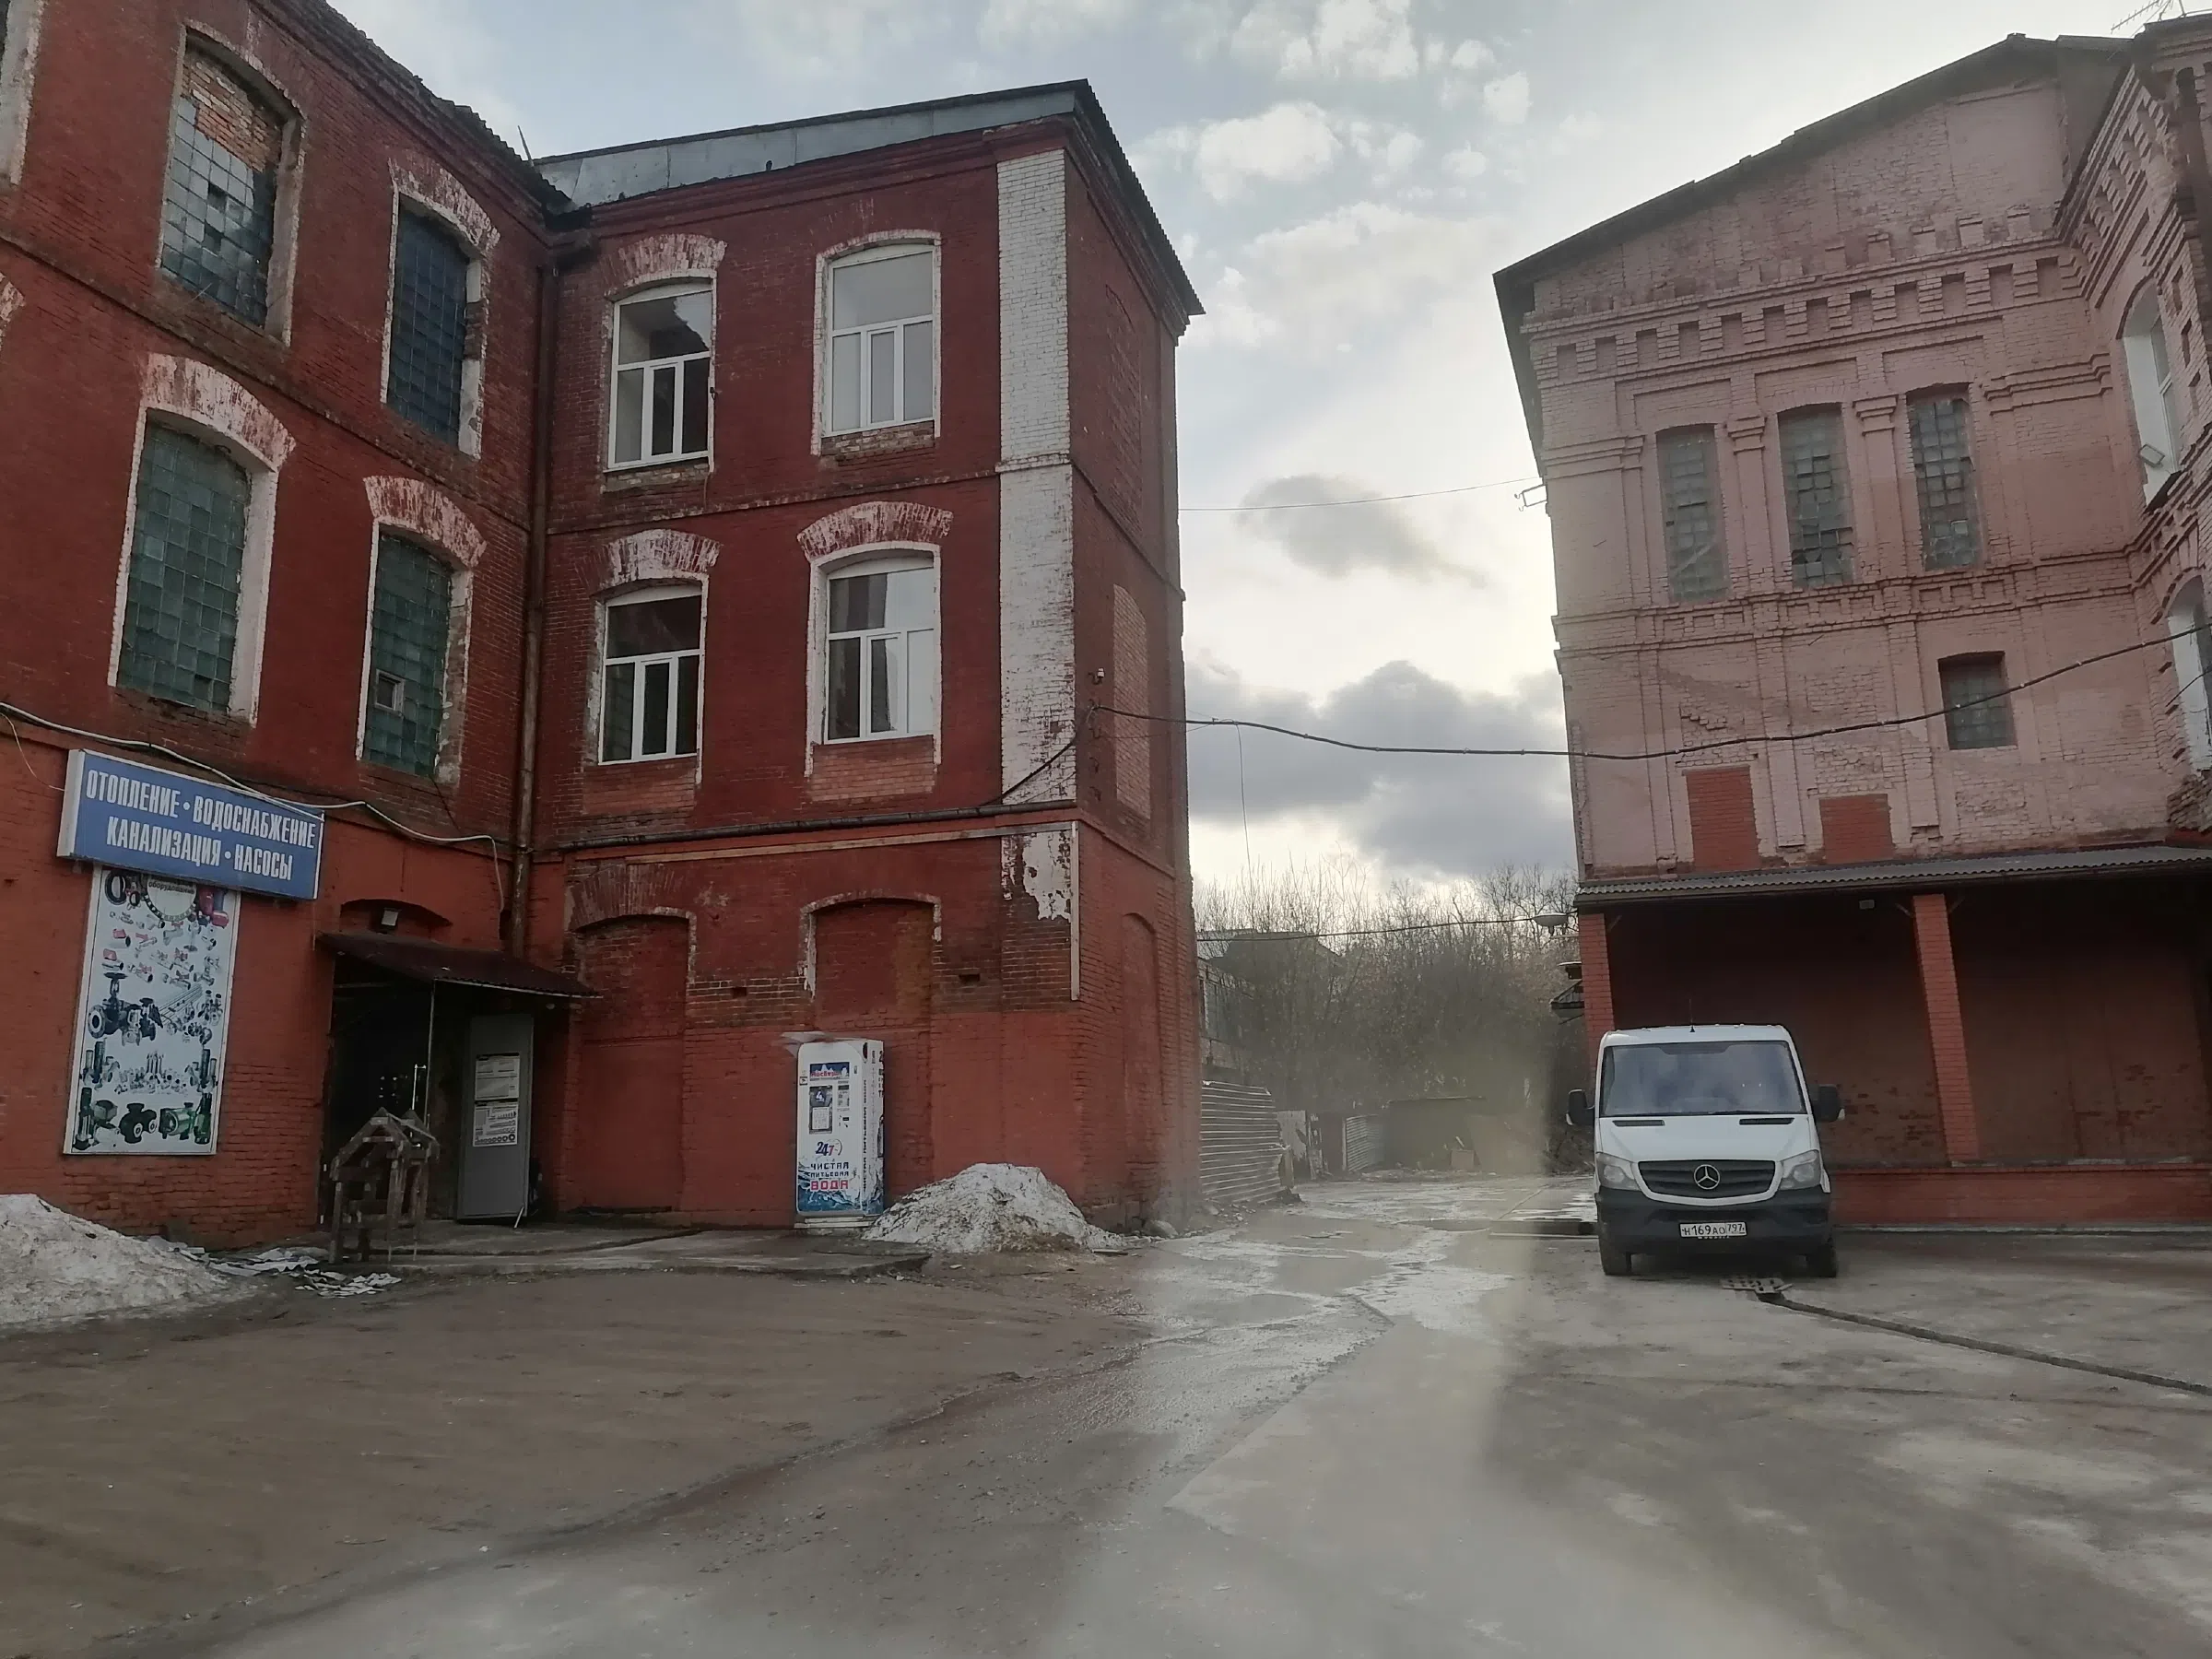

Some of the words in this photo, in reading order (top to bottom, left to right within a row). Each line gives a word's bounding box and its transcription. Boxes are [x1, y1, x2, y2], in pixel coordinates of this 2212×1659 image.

[86, 769, 181, 818] ОТОПЛЕНИЕ
[192, 795, 317, 849] ВОДОСНАБЖЕНИЕ
[106, 816, 222, 867] КАНАЛИЗАЦИЯ
[233, 844, 293, 881] НАСОСЫ
[811, 1161, 849, 1171] ЧИСТАЯ
[810, 1179, 849, 1190] ВОДА
[1727, 1223, 1743, 1232] 797
